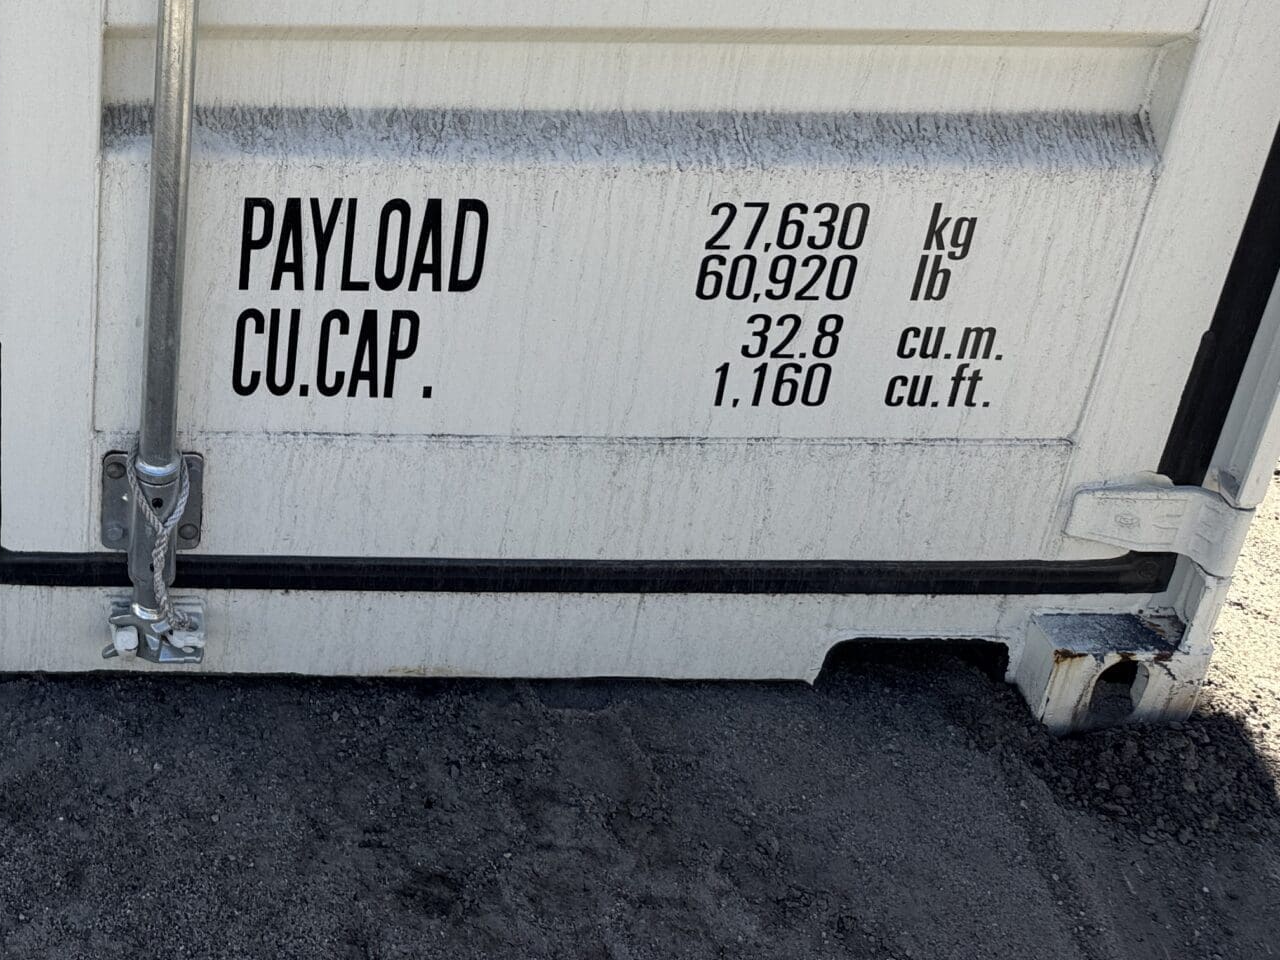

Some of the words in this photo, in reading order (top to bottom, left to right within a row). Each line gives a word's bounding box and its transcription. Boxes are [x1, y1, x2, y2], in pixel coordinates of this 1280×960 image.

[238, 197, 489, 292] PAYLOAD
[704, 202, 871, 253] 27,630
[922, 202, 978, 261] kg
[695, 254, 858, 303] 60,920
[909, 254, 952, 301] lb
[740, 313, 844, 359] 32.8
[896, 326, 1003, 361] cu.m.
[713, 362, 832, 408] 1,160
[884, 363, 991, 408] cu.ft.
